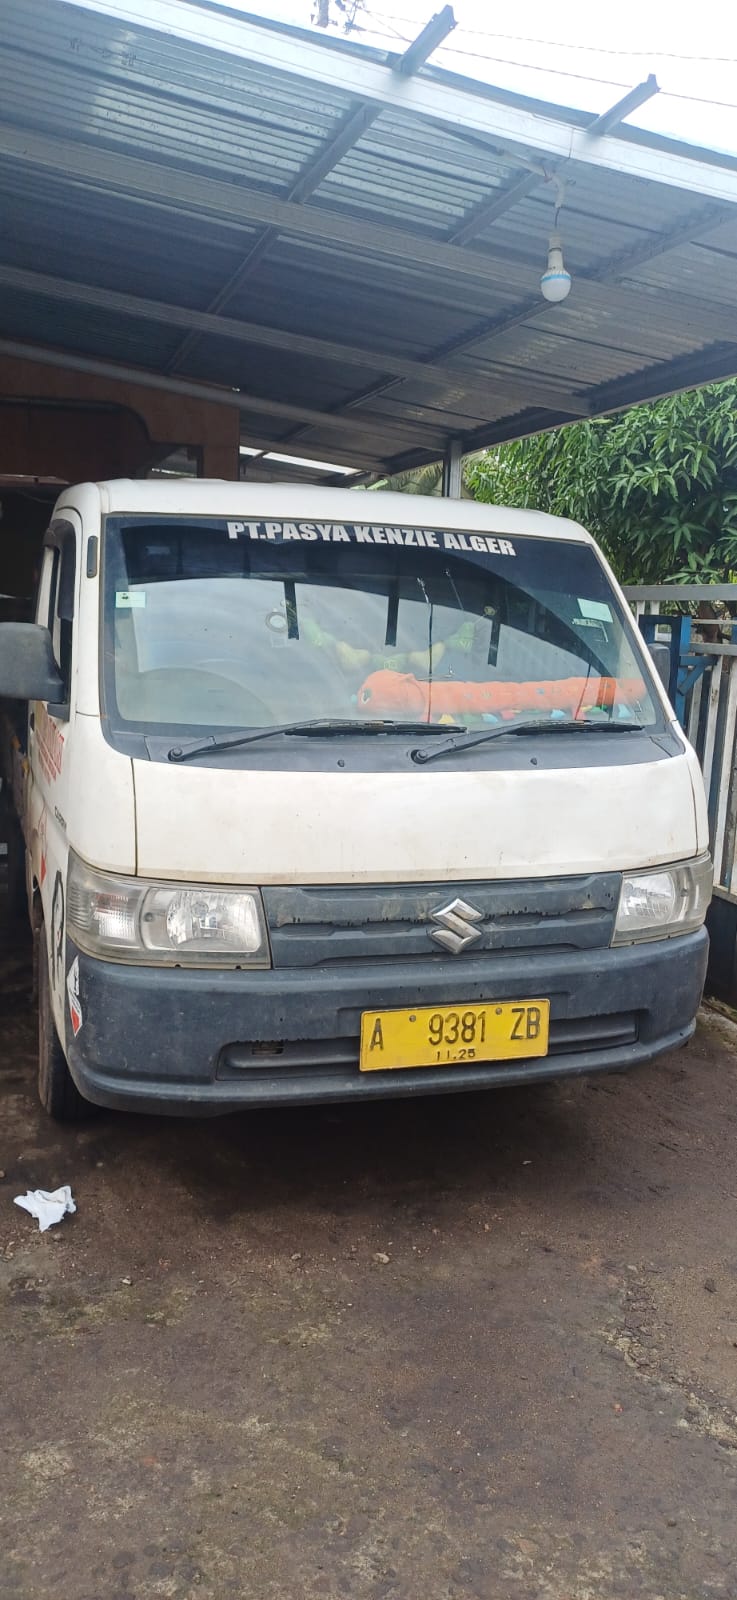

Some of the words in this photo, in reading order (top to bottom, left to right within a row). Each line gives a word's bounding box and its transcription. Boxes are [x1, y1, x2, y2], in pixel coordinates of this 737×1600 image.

[226, 521, 351, 543] PT.PASYA
[353, 525, 441, 548] KENZIE
[444, 533, 517, 556] ALGER
[369, 1018, 384, 1051] A
[428, 1010, 487, 1046] 9381
[510, 1007, 541, 1040] ZB
[436, 1048, 476, 1062] 11.25
